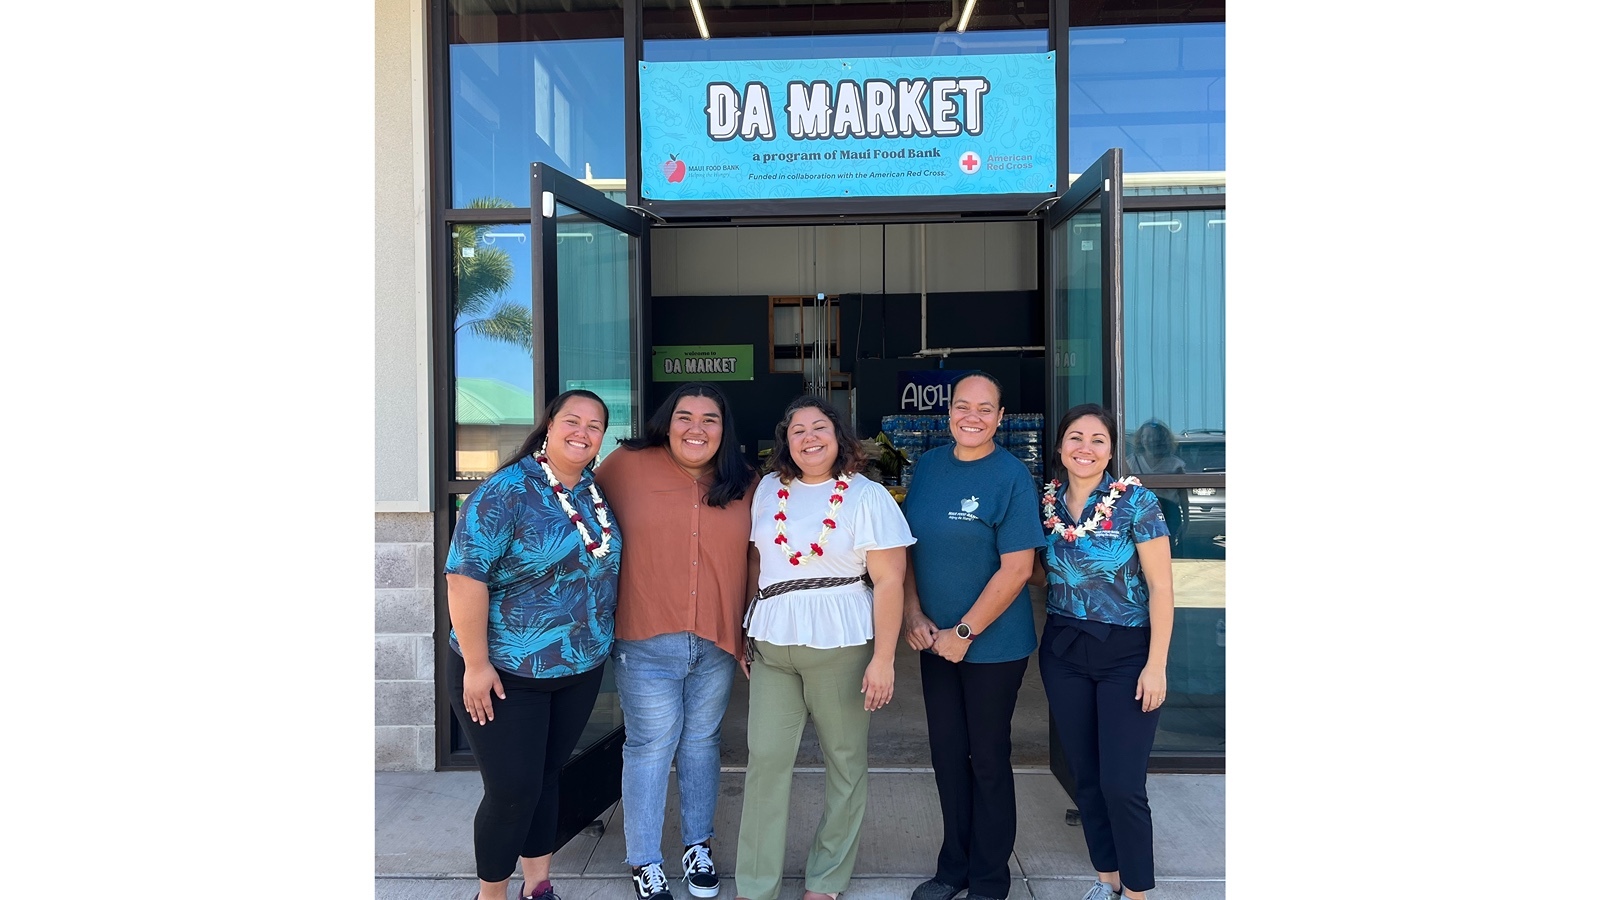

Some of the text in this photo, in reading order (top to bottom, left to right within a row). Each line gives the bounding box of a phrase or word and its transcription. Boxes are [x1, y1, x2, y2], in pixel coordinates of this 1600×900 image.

[705, 76, 990, 140] DA MARKET
[752, 147, 942, 164] a program of Maui Food Bank
[986, 153, 1033, 162] American
[748, 169, 947, 180] Funded in collaboration with the American Red Cross.
[986, 162, 1033, 171] Red Cross
[664, 357, 737, 374] DA MARKET
[901, 382, 951, 411] ALOH
